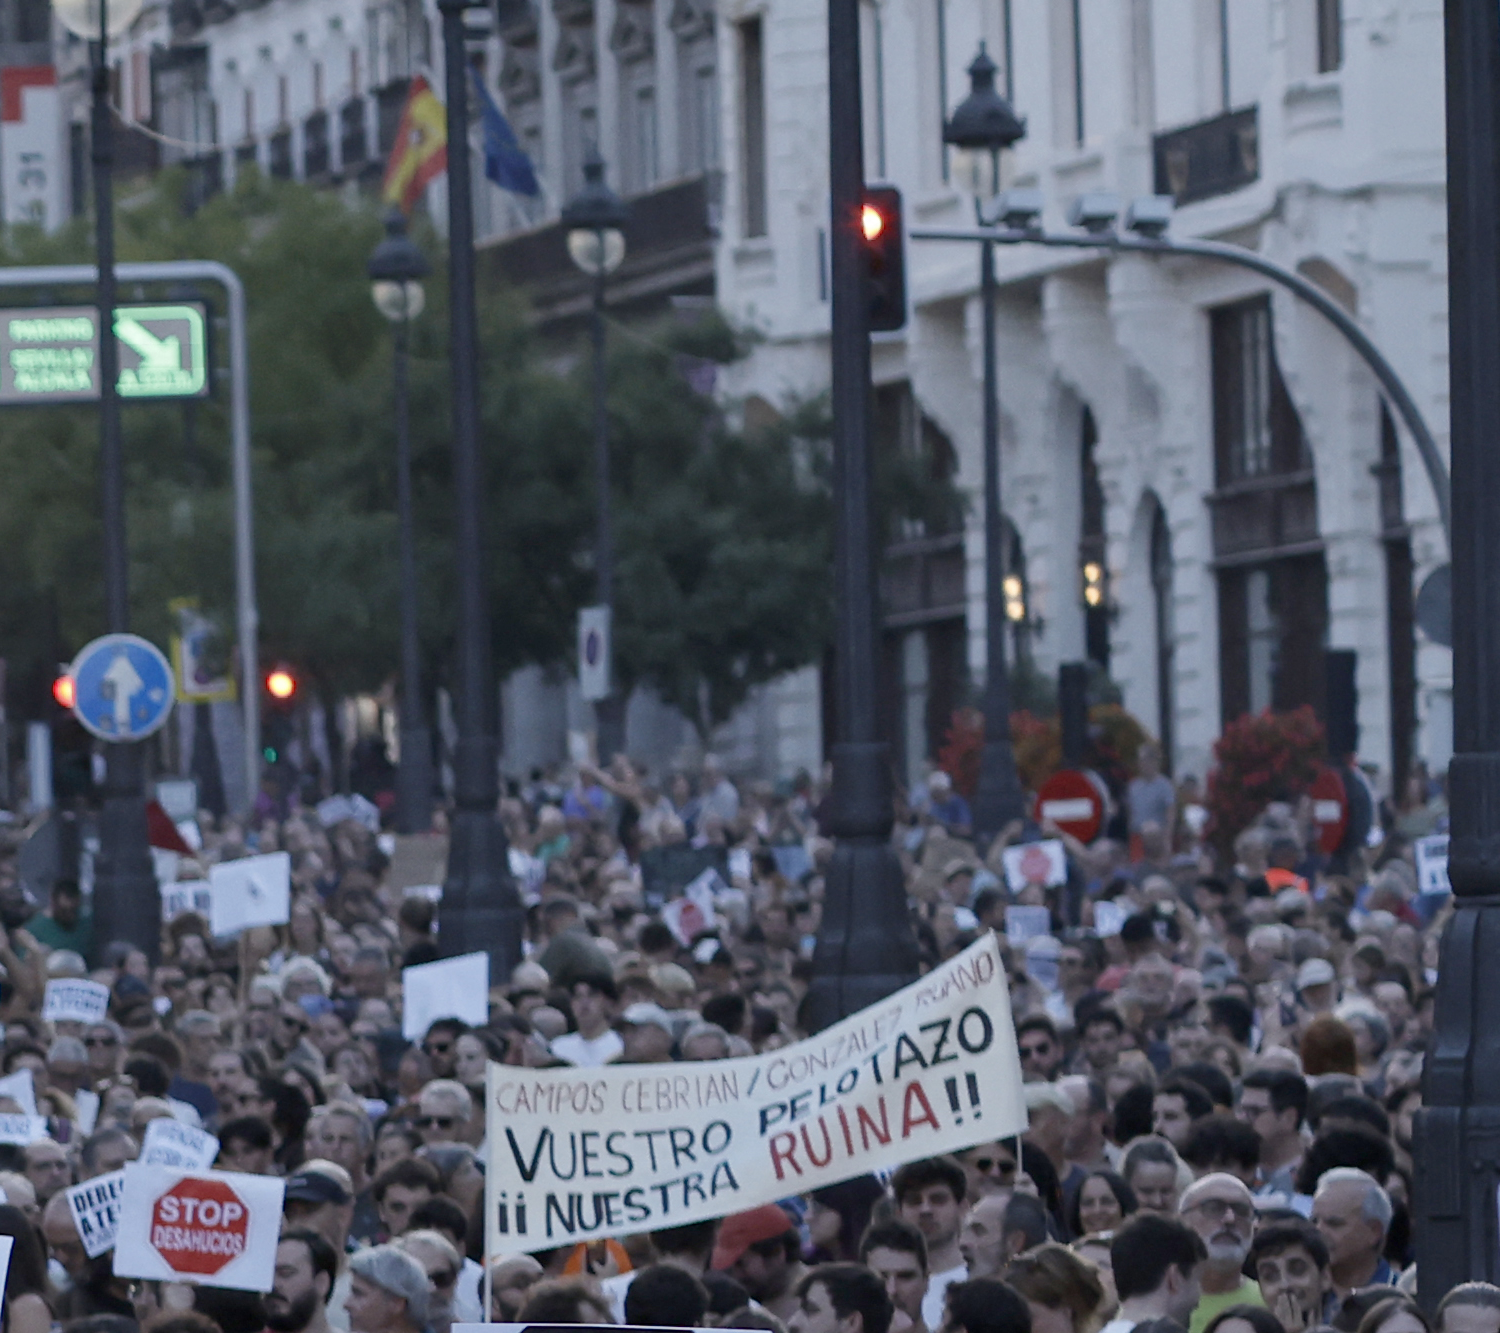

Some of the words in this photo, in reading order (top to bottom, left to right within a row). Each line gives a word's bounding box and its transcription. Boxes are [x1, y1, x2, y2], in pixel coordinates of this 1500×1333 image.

[495, 1073, 613, 1116] CAMPOS
[504, 1115, 734, 1183] VUESTRO
[756, 1003, 995, 1133] PELOTAZO
[73, 1177, 124, 1213] DERE
[158, 1196, 243, 1230] STOP
[152, 1225, 243, 1257] DESAHUCIOS
